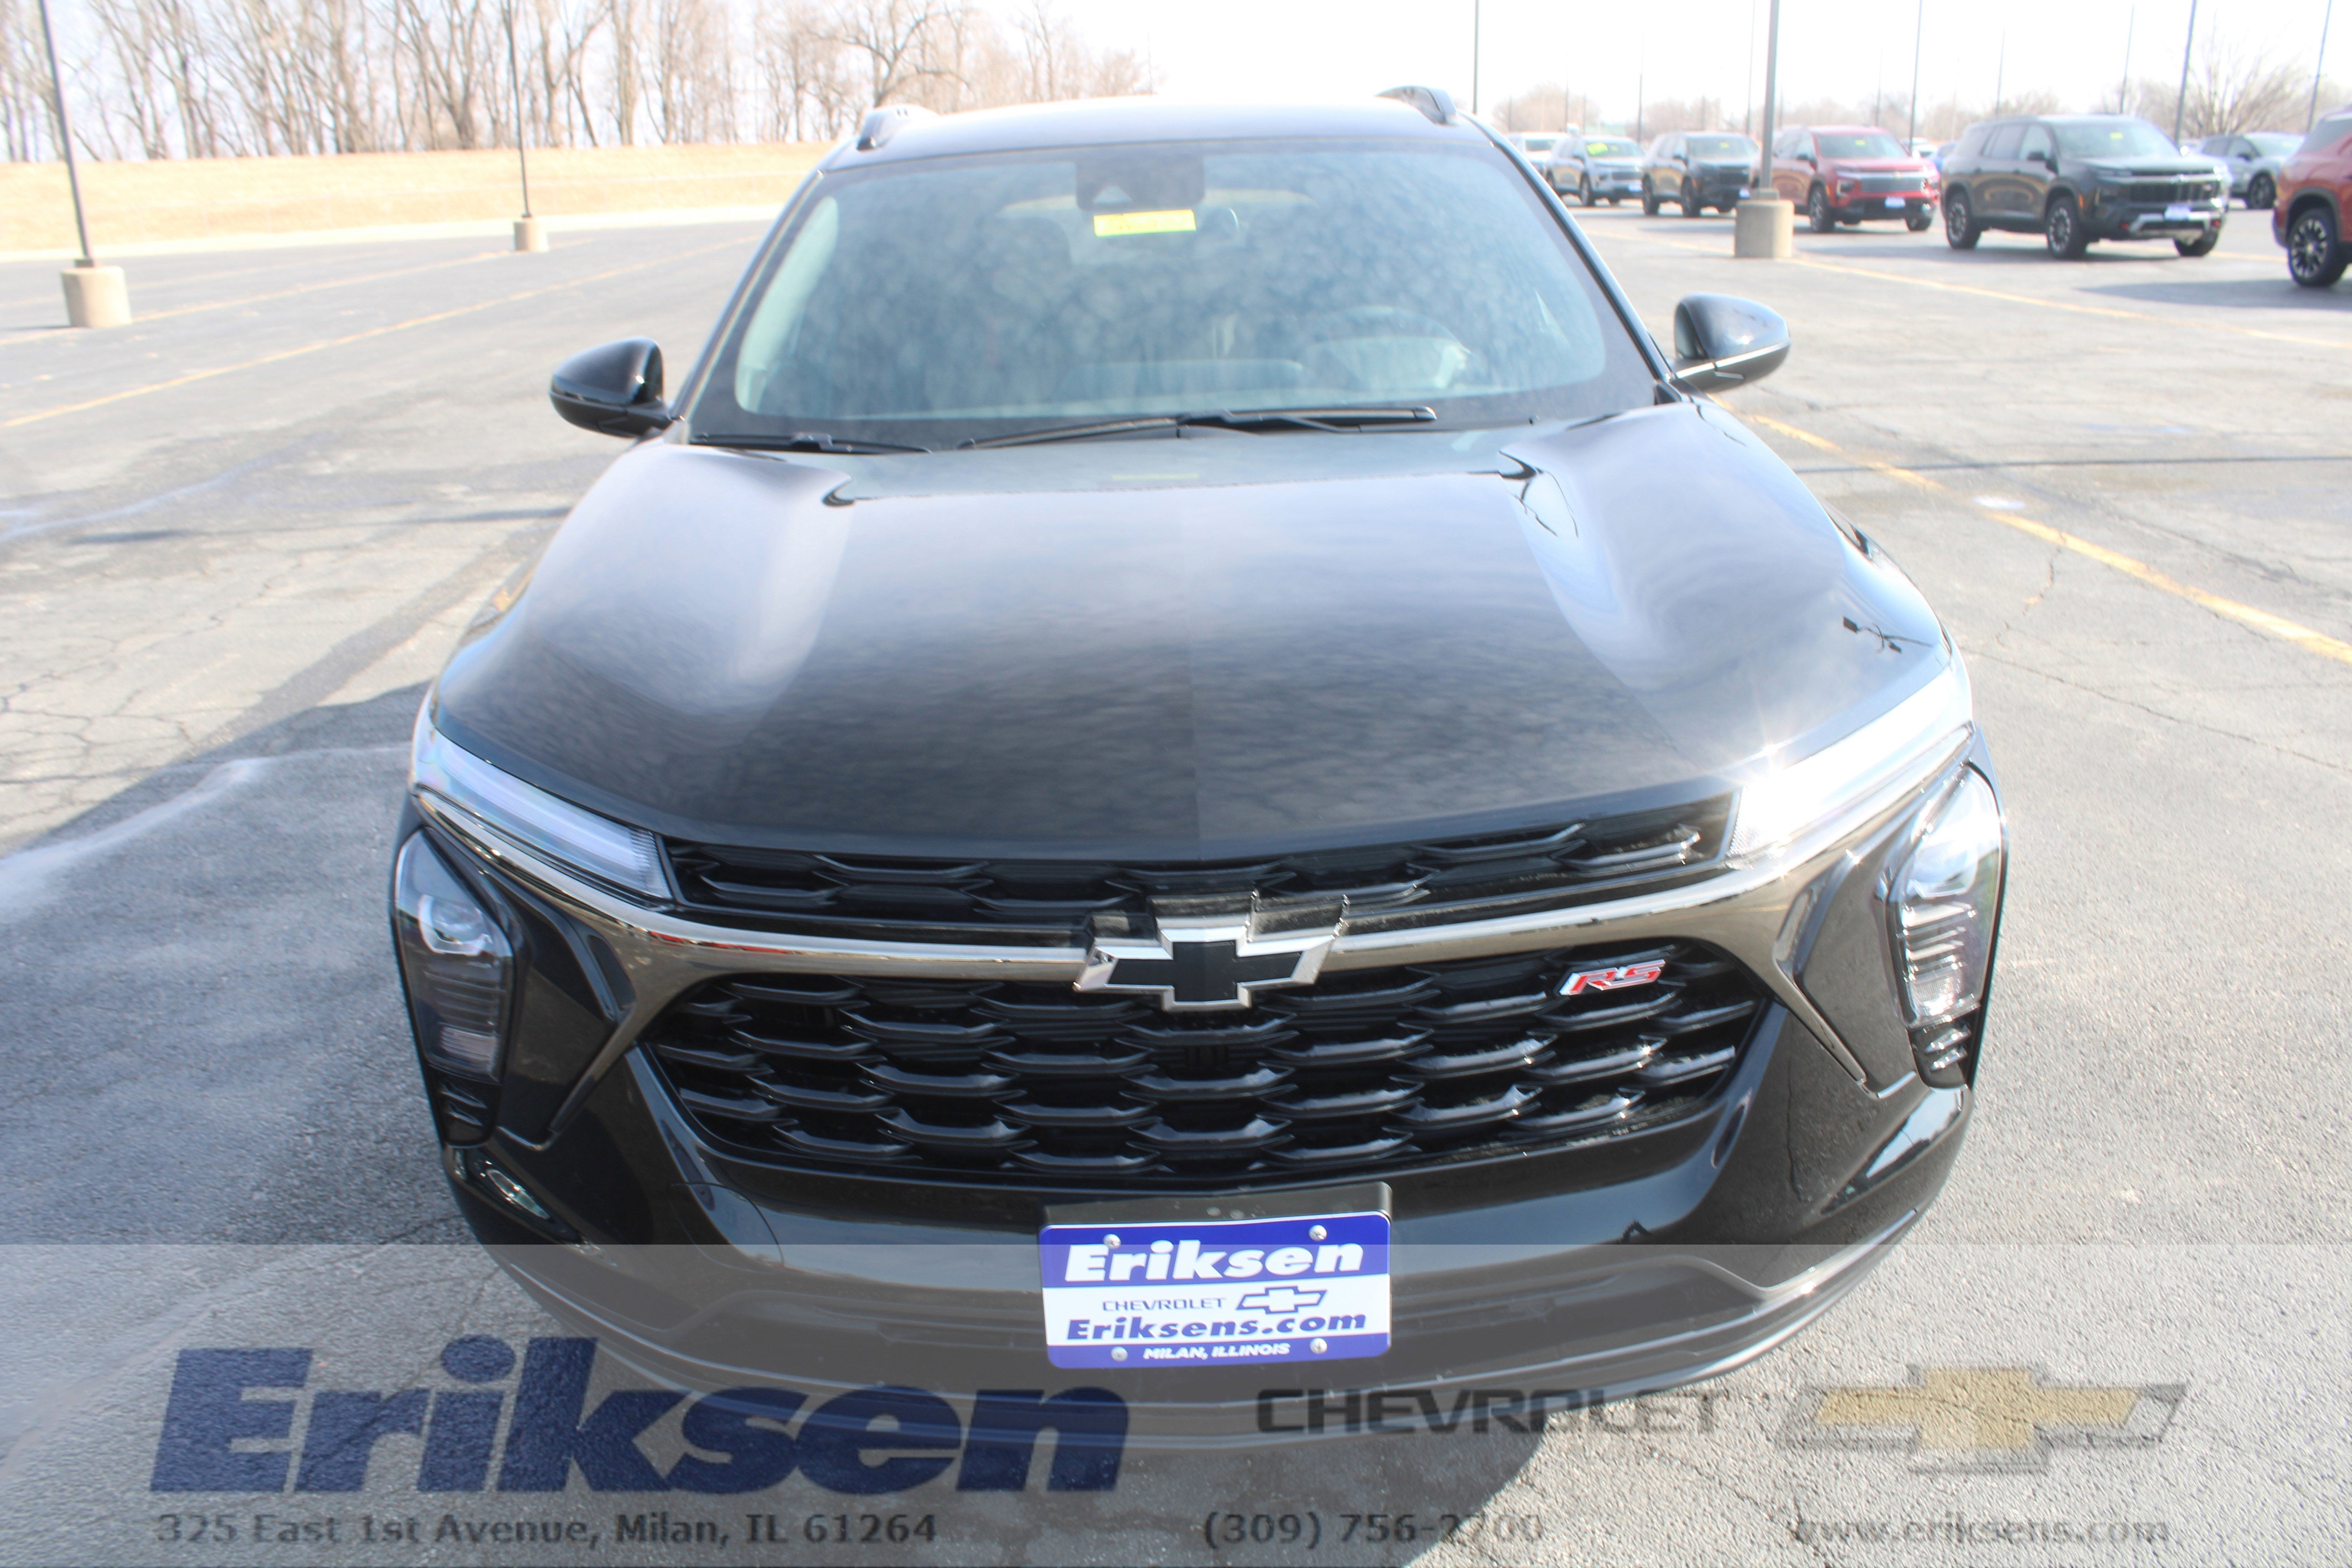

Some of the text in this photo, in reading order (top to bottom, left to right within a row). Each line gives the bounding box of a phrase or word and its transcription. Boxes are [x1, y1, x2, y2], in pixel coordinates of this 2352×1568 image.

[1559, 959, 1666, 996] RS
[1065, 1239, 1364, 1282] Eriksen
[1102, 1298, 1226, 1311] CHEVROLET
[1067, 1314, 1366, 1340] Eriksens.com
[1143, 1342, 1291, 1360] MILAN, ILLINOIS
